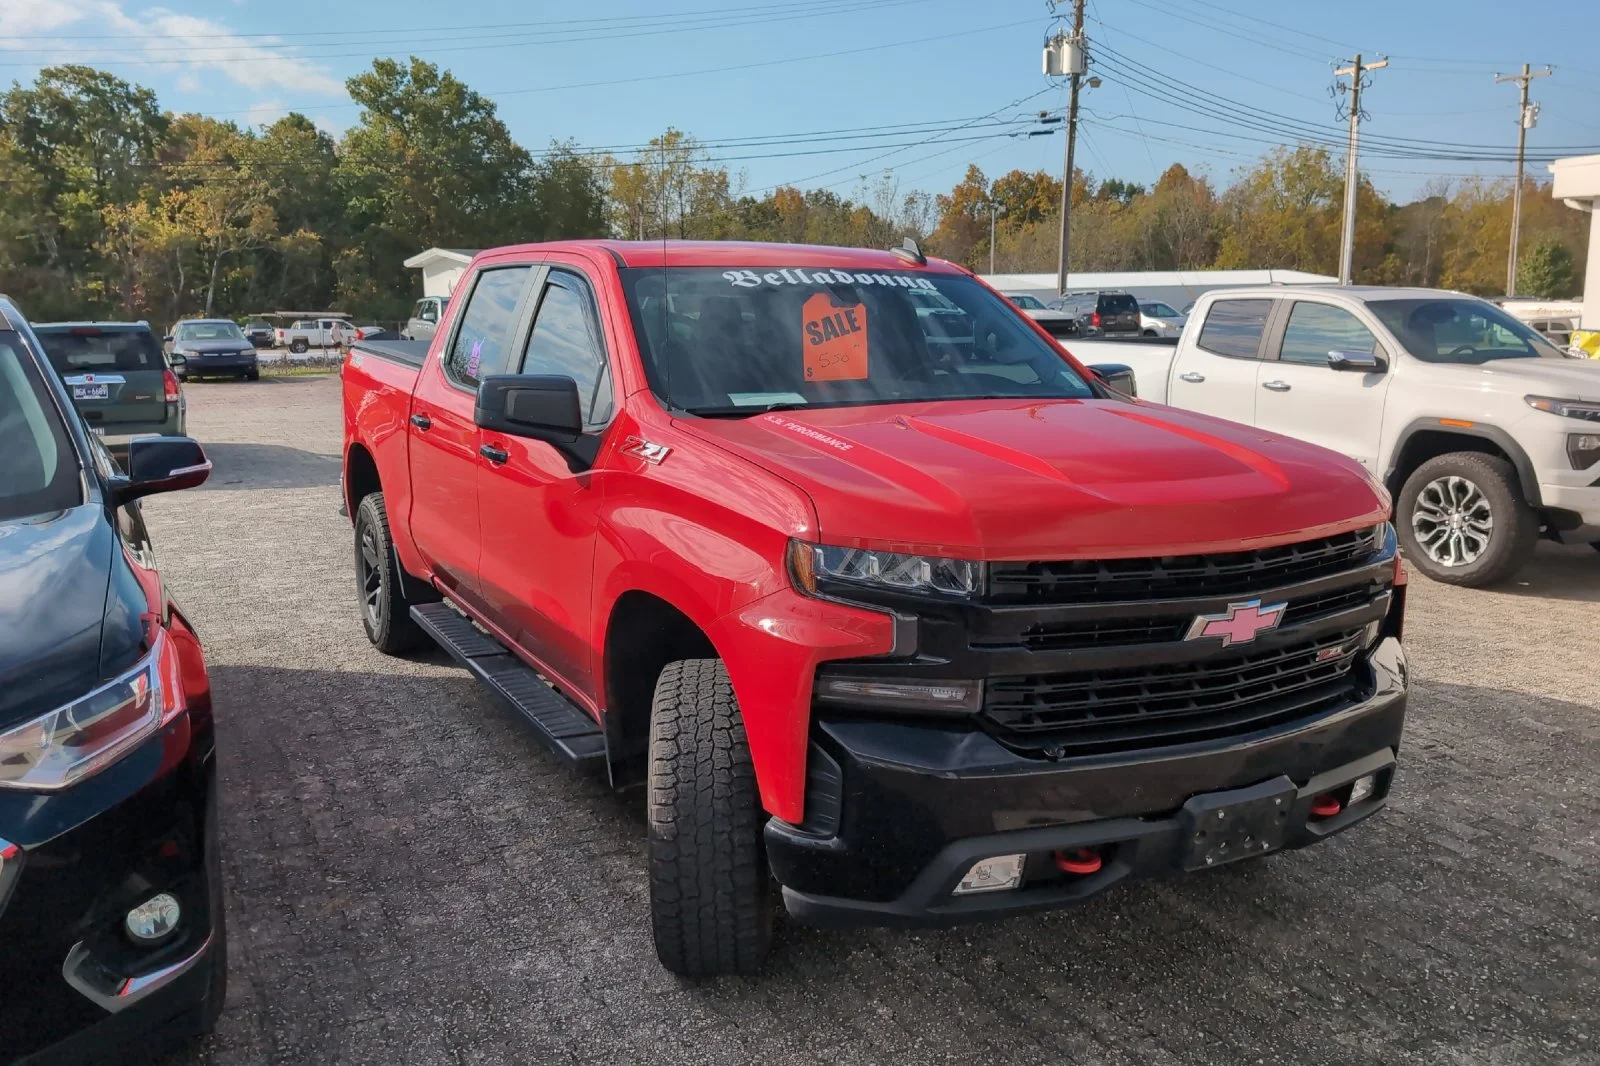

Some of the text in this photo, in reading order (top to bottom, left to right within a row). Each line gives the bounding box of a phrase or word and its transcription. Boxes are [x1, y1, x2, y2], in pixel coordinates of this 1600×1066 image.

[722, 268, 938, 291] Belladonna
[805, 308, 862, 346] SALE
[807, 367, 813, 377] $
